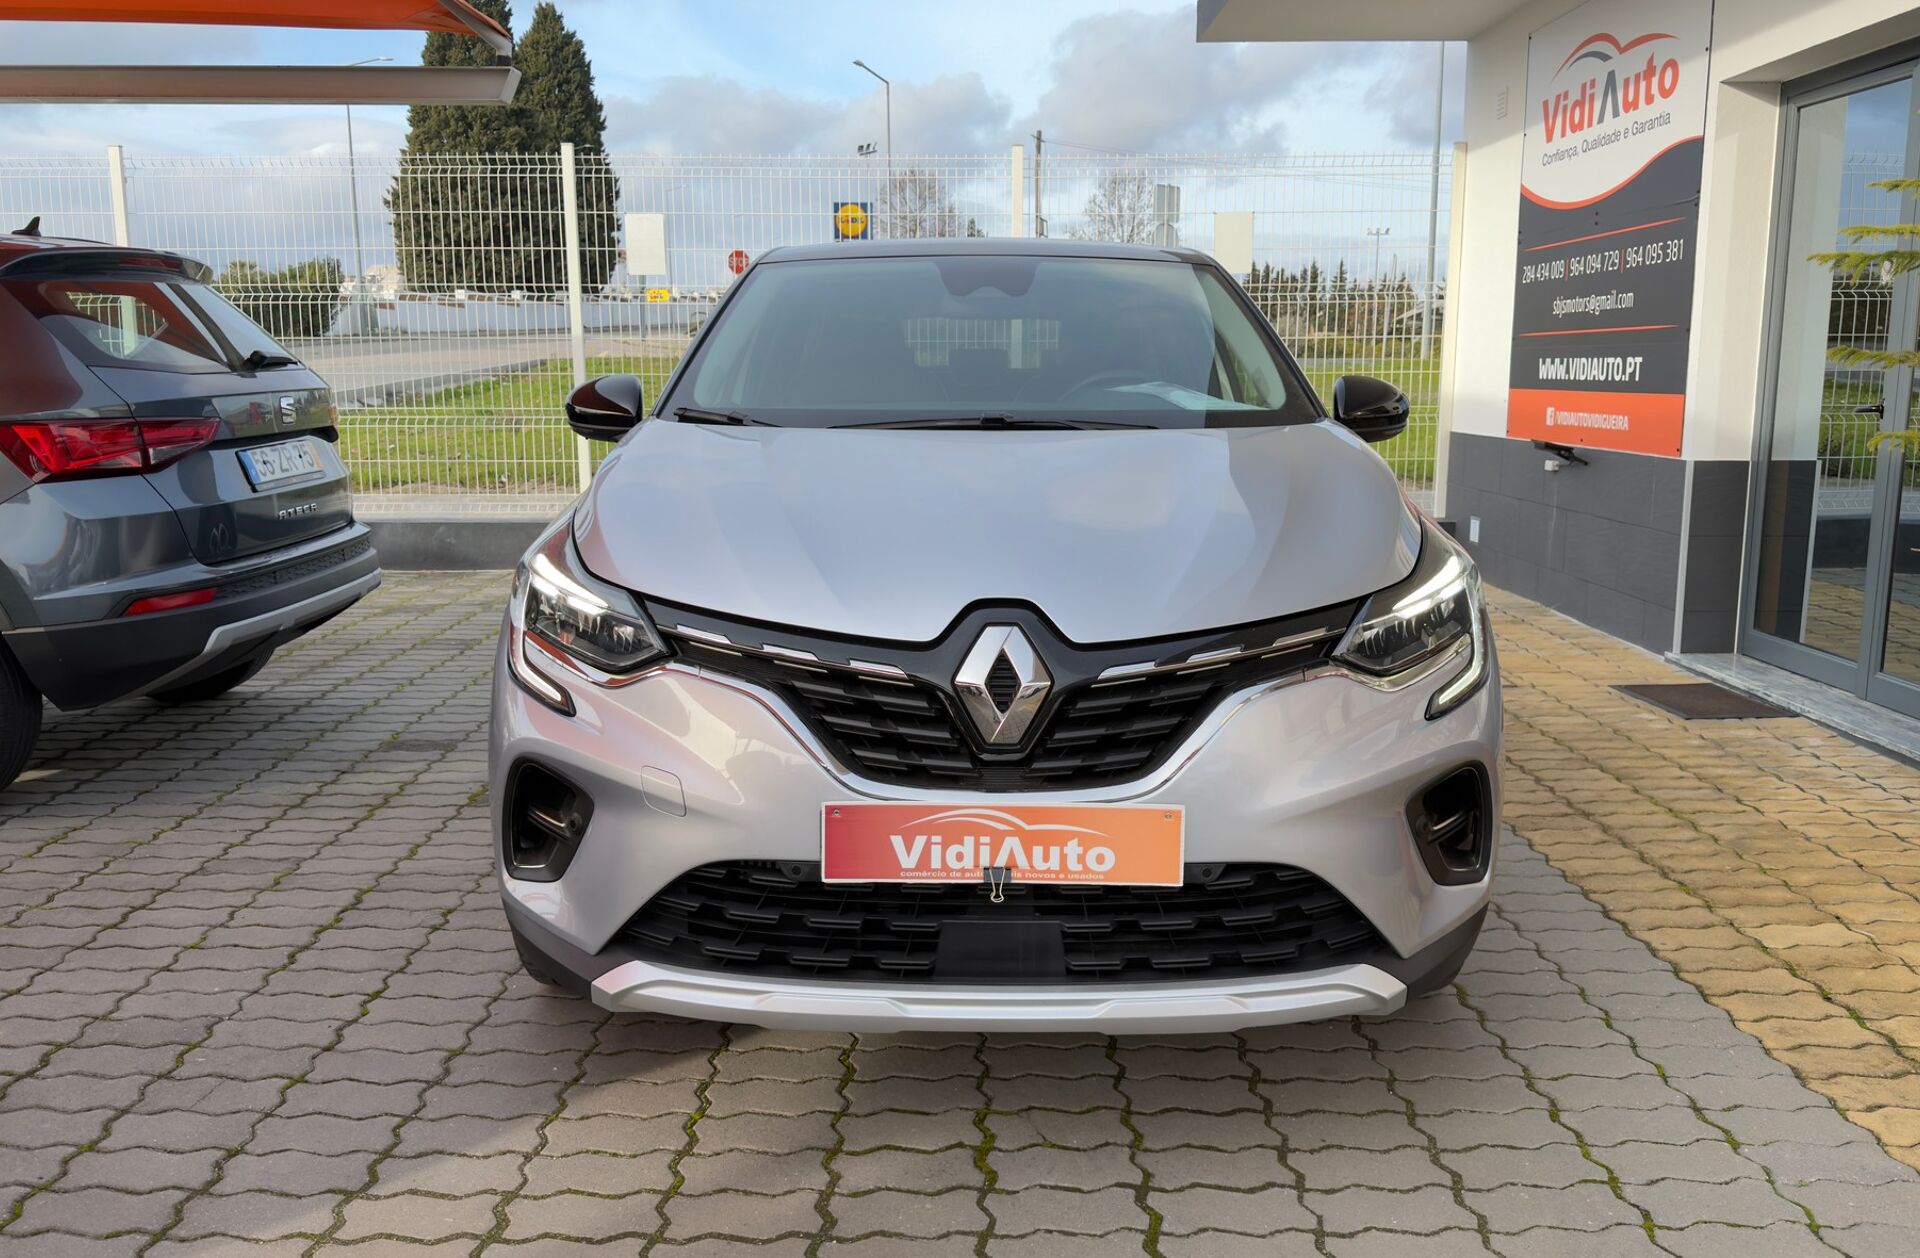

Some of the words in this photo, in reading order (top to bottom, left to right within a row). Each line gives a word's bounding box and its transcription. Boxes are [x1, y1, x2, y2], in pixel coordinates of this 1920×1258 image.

[1542, 51, 1680, 144] VidiAuto
[1541, 143, 1579, 166] Confiança,
[1581, 127, 1621, 154] Qualidade
[1623, 127, 1629, 139] e
[1631, 111, 1671, 136] Garantia
[1522, 265, 1535, 284] 284
[1536, 262, 1550, 281] 434
[1551, 259, 1565, 280] 009
[1570, 257, 1584, 277] 964
[1586, 254, 1601, 274] 094
[1603, 250, 1620, 272] 729
[1626, 247, 1643, 268] 964
[1645, 243, 1663, 265] 095
[1665, 239, 1684, 262] 381
[1552, 289, 1634, 318] sbjsmotors@gmail.com
[1538, 356, 1643, 382] WWW.VIDIAUTO.PT
[889, 834, 1116, 872] VidiAuto
[900, 869, 947, 878] comércio
[949, 870, 962, 878] de
[1025, 871, 1056, 879] novos
[1068, 871, 1104, 880] usados
